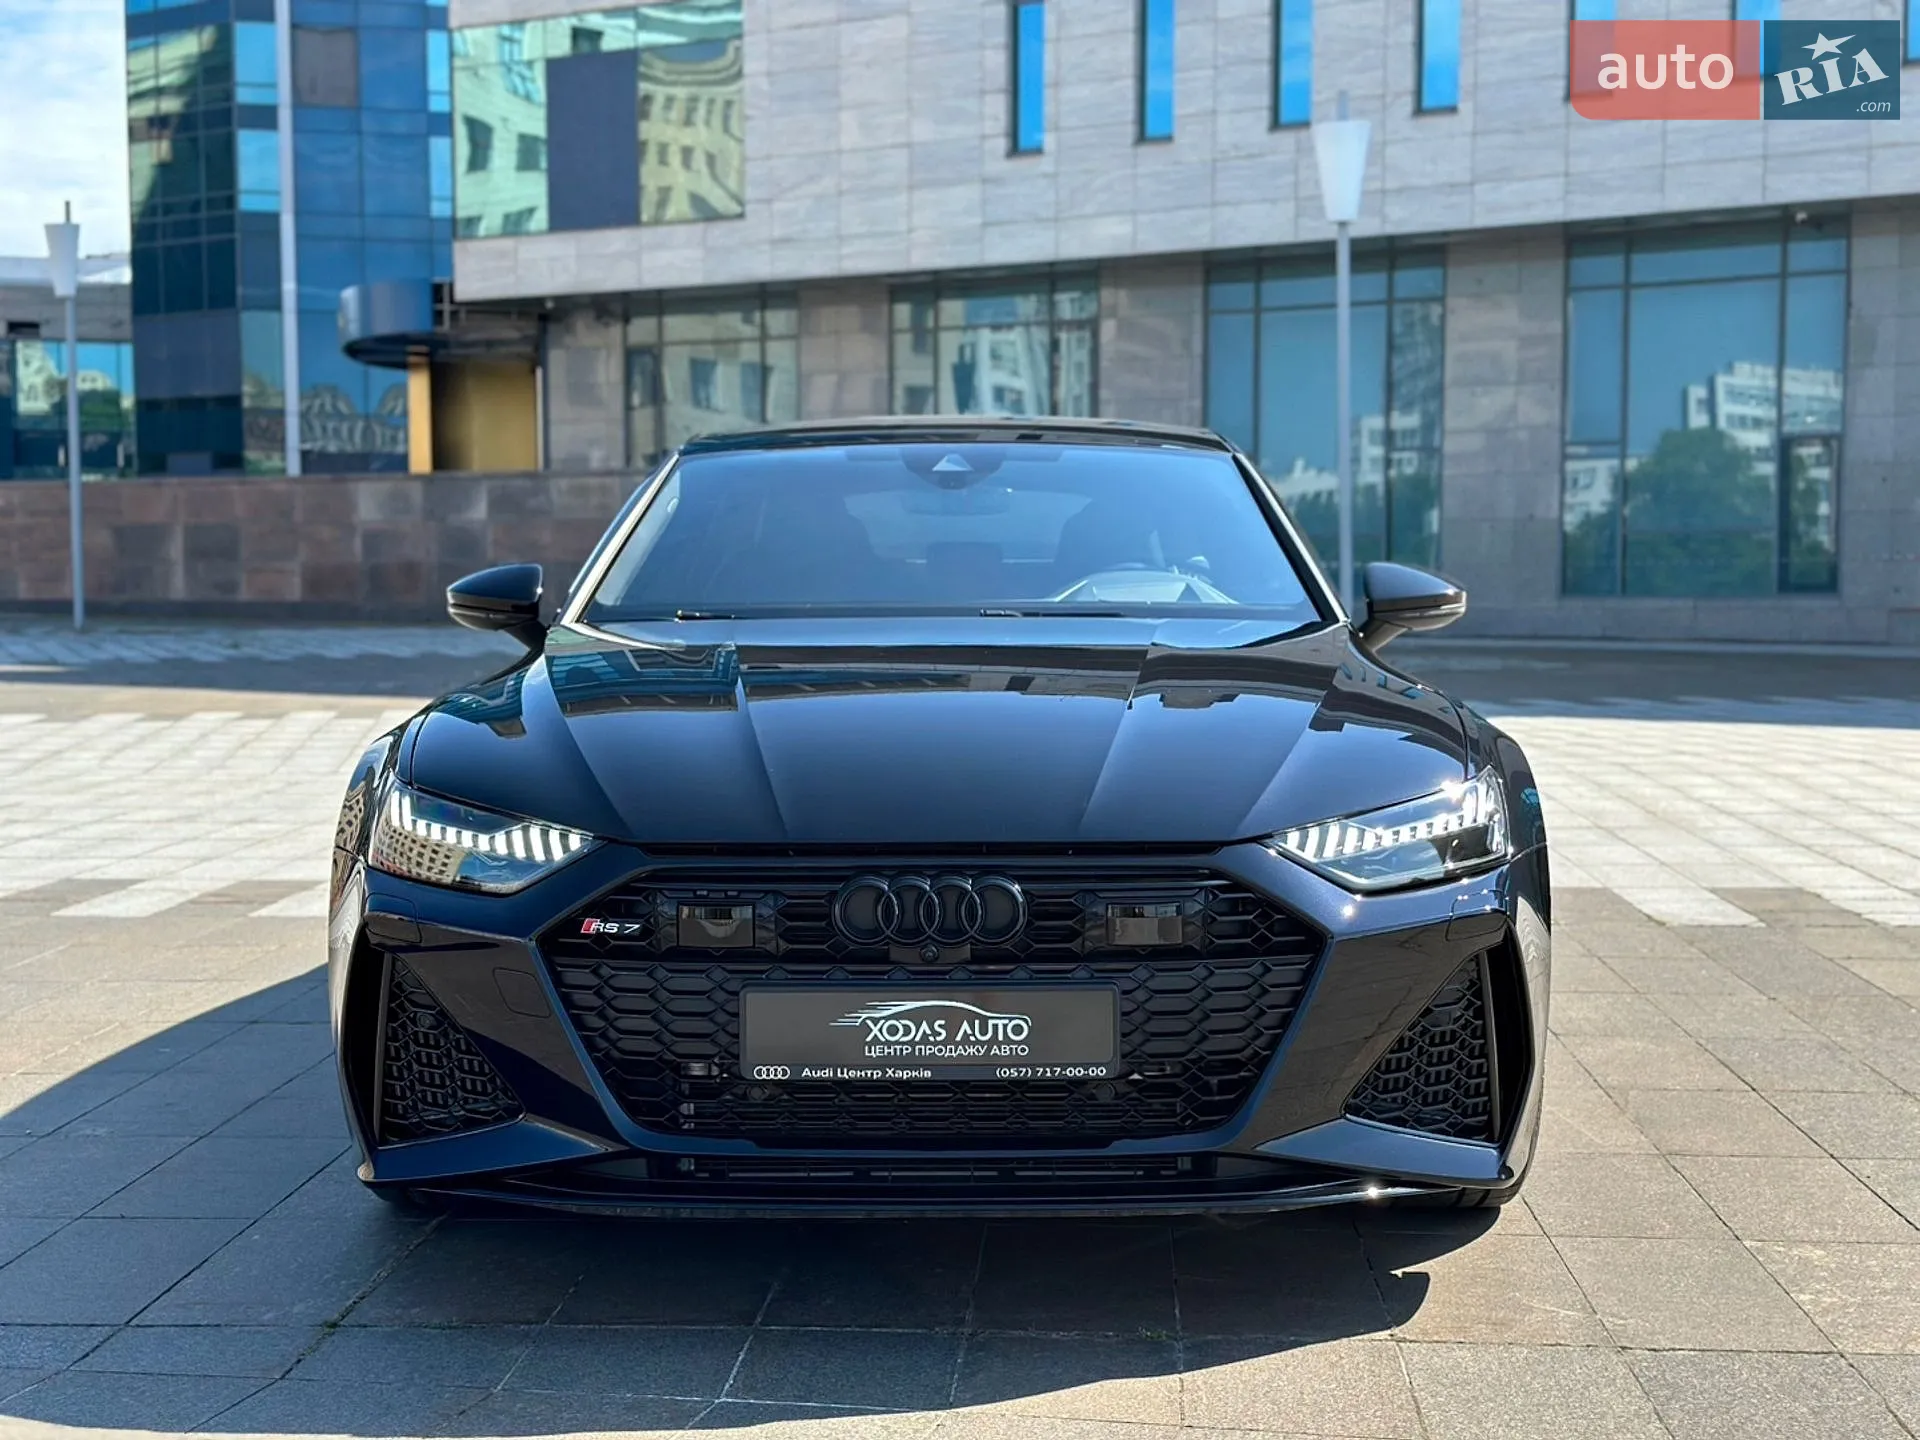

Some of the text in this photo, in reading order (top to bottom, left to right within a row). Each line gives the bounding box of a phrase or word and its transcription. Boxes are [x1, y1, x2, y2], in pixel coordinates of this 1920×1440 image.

[588, 921, 641, 934] RS 7
[865, 1019, 1031, 1042] XODAS AUTO
[864, 1045, 1030, 1058] ЦЕНТР ПРОДАЖУ АВТО
[801, 1067, 932, 1080] Audi Центр Харків
[995, 1066, 1107, 1078] (057) 717-00-00
